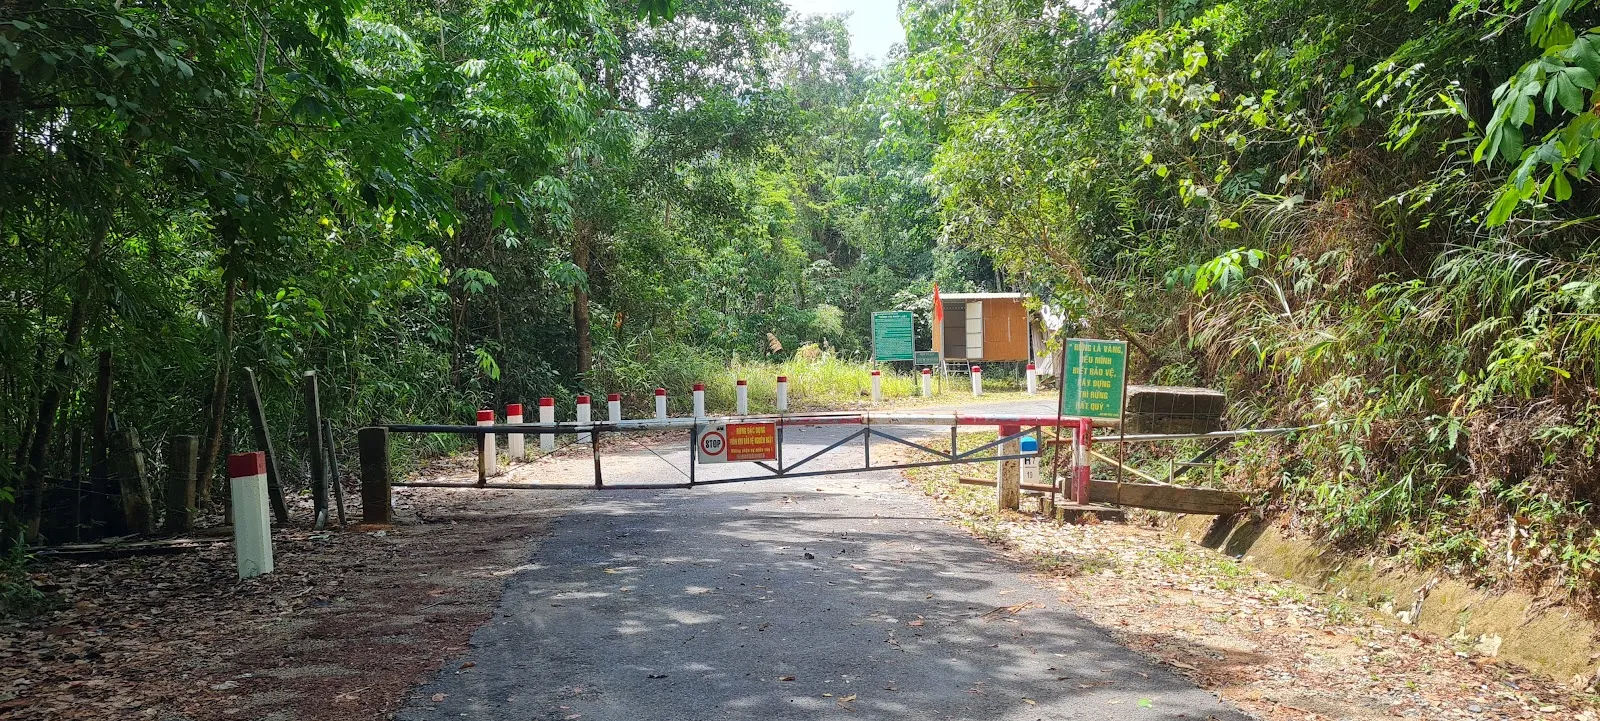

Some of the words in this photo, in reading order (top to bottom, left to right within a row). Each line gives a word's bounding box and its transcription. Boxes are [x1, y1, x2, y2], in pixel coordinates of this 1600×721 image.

[1093, 343, 1101, 352] LÀ
[1090, 366, 1104, 376] BẢO
[706, 440, 721, 448] STOP
